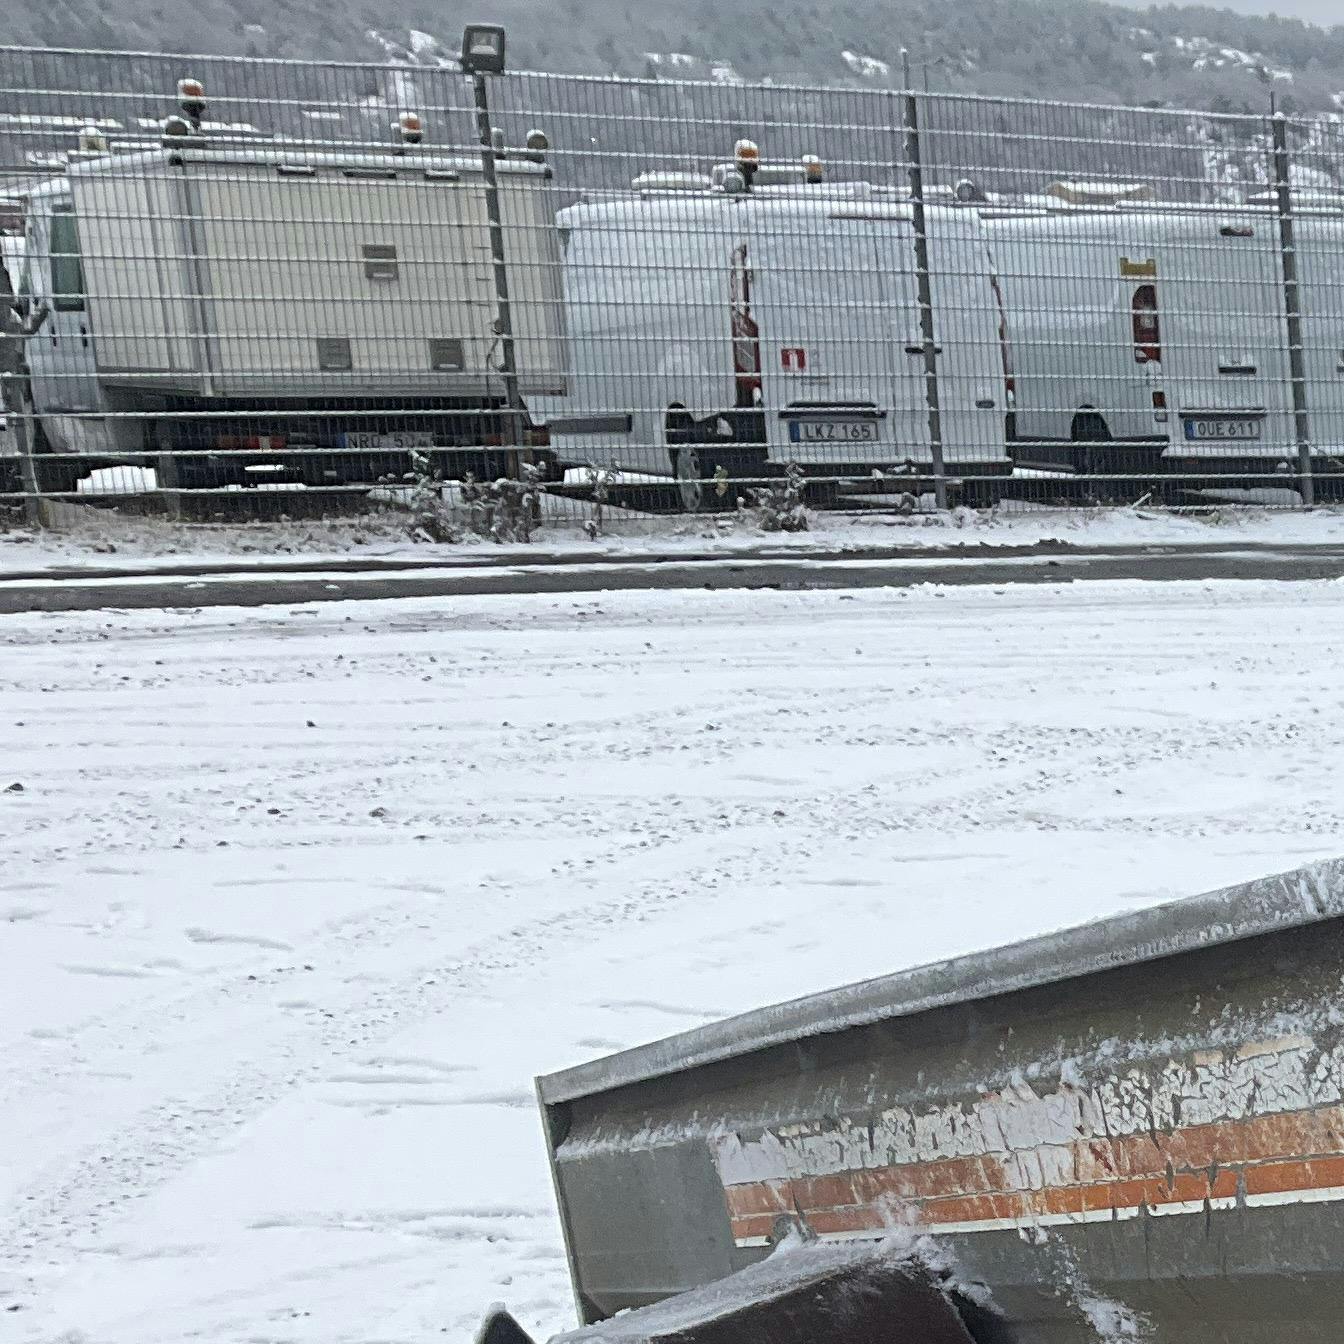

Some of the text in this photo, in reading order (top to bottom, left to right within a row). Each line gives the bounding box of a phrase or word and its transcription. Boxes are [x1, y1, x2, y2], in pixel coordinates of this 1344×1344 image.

[806, 424, 870, 438] LKZ 165
[1229, 422, 1254, 436] 611
